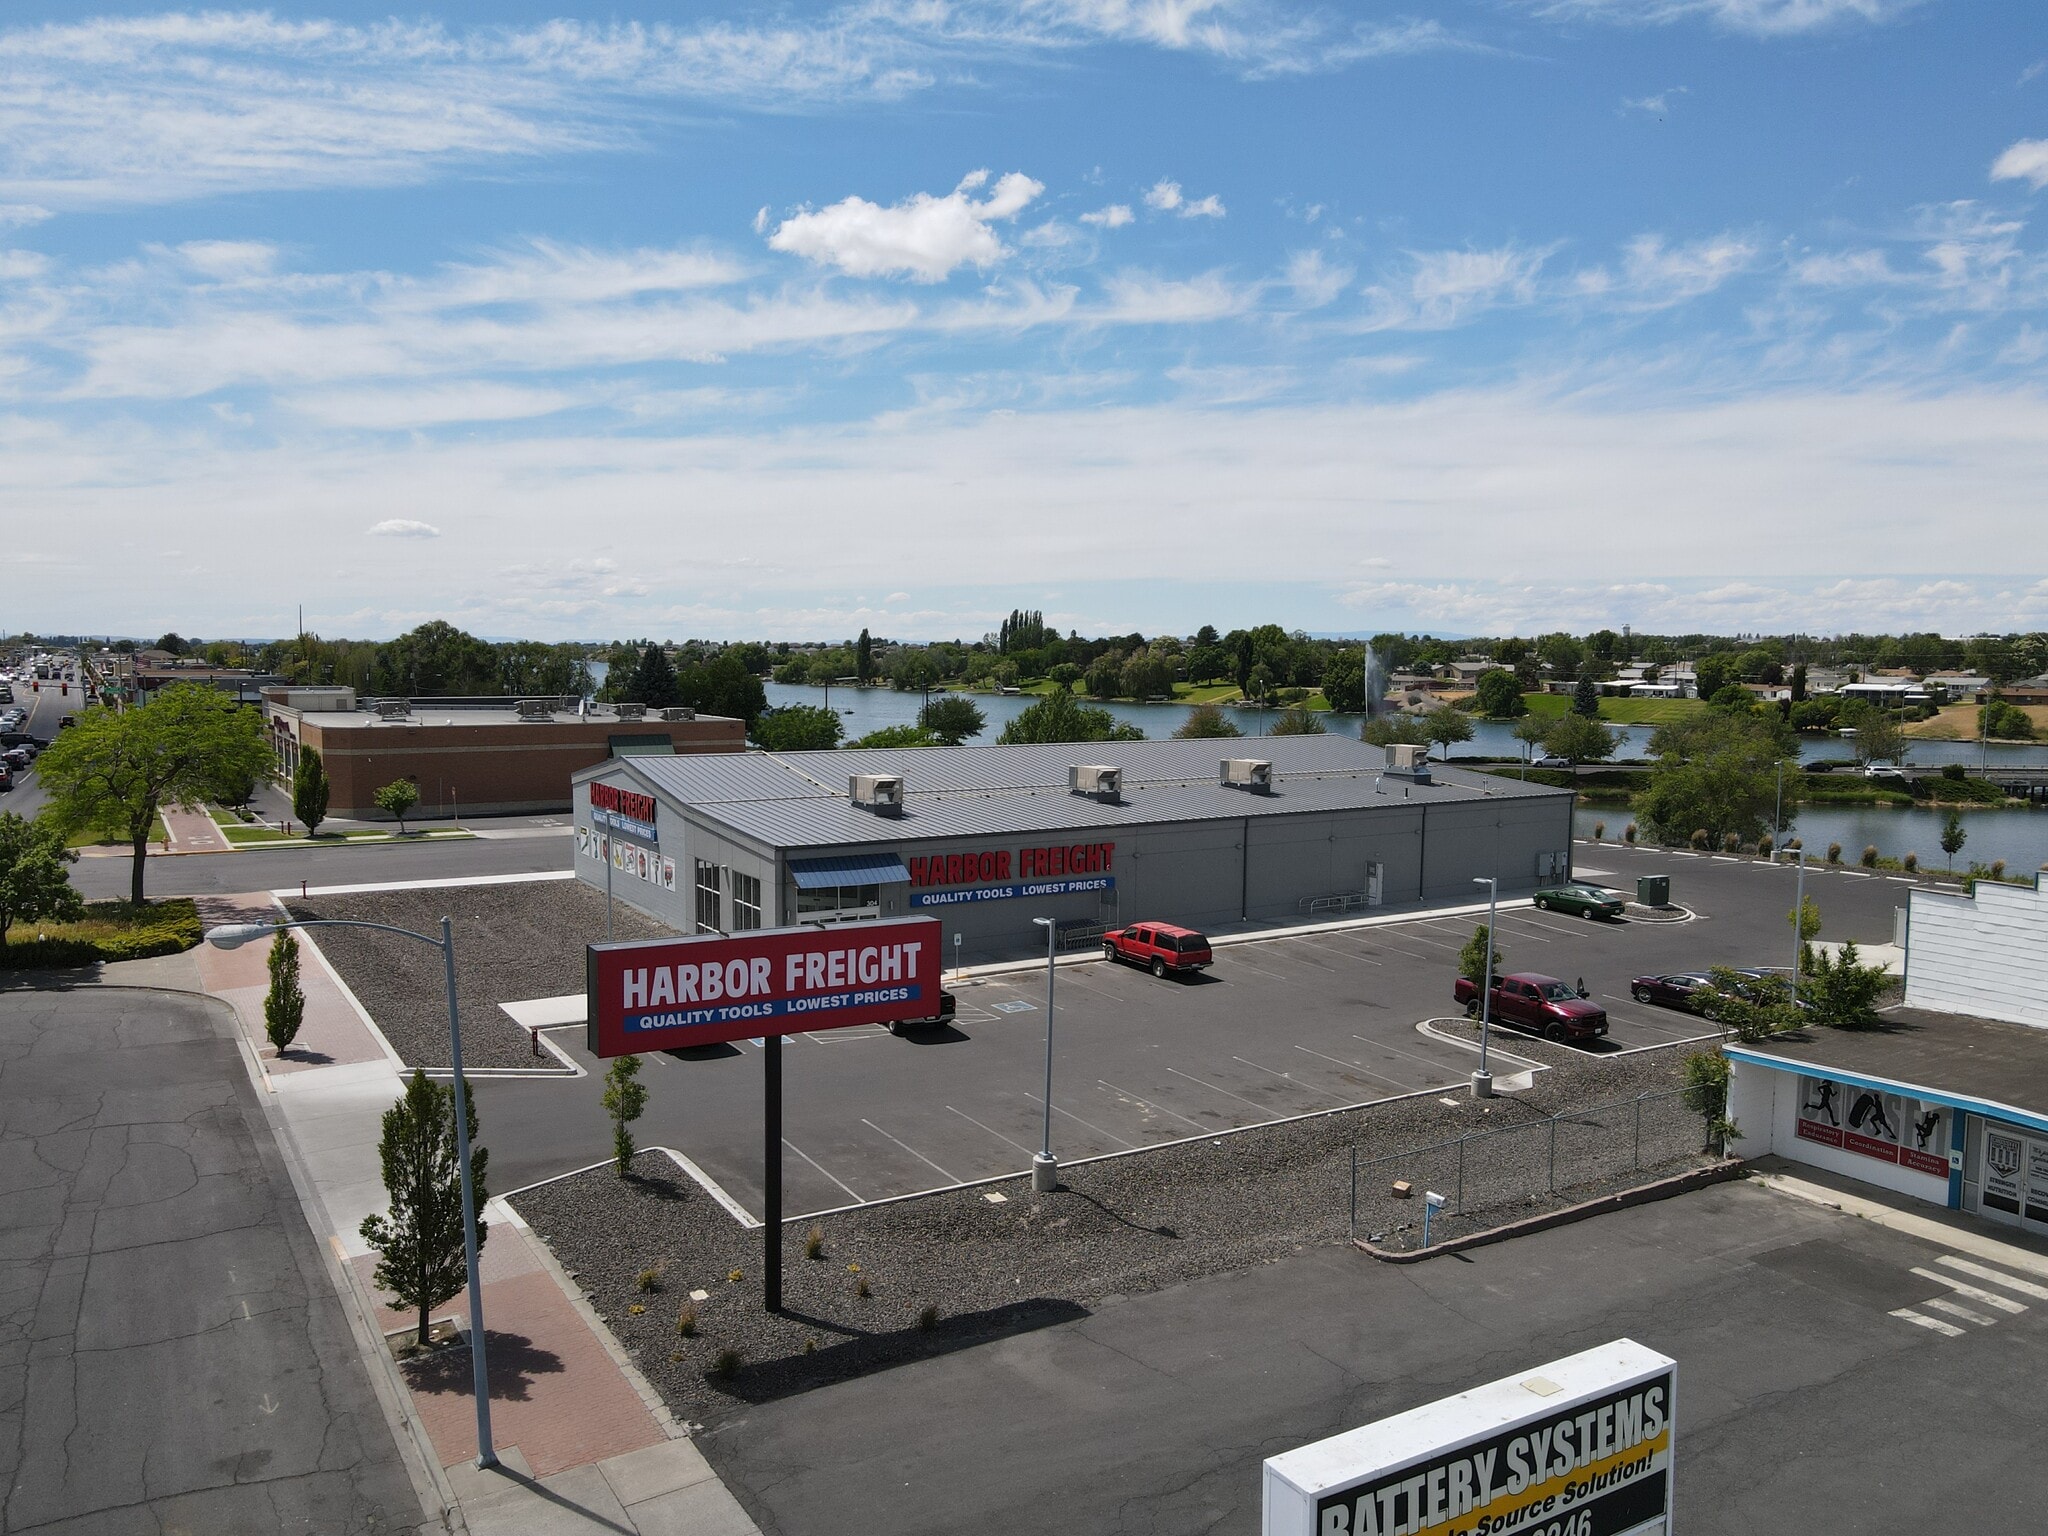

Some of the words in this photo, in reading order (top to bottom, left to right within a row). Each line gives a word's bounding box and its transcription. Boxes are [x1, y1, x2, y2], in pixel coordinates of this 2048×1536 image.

[909, 850, 1012, 887] HARBOR
[1020, 842, 1116, 879] FREIGHT
[922, 890, 974, 905] QUALITY
[975, 887, 1013, 900] TOOLS
[1022, 882, 1066, 896] LOWEST
[1069, 878, 1107, 892] PRICES
[623, 956, 771, 1009] HARBOR
[786, 942, 922, 992] FREIGHT
[639, 1009, 714, 1029] QUALITY
[718, 1002, 773, 1019] TOOLS
[787, 993, 849, 1013] LOWEST
[854, 987, 909, 1005] PRICES
[1802, 1121, 1840, 1137] Respiratory
[1802, 1128, 1838, 1144] Endurance
[1849, 1138, 1894, 1156] Coordination
[1909, 1151, 1940, 1165] Stamina
[1907, 1158, 1942, 1174] Accuracy
[1506, 1385, 1665, 1496] SYSTEMS
[1477, 1493, 1556, 1536] Source
[1562, 1448, 1654, 1505] Solution!
